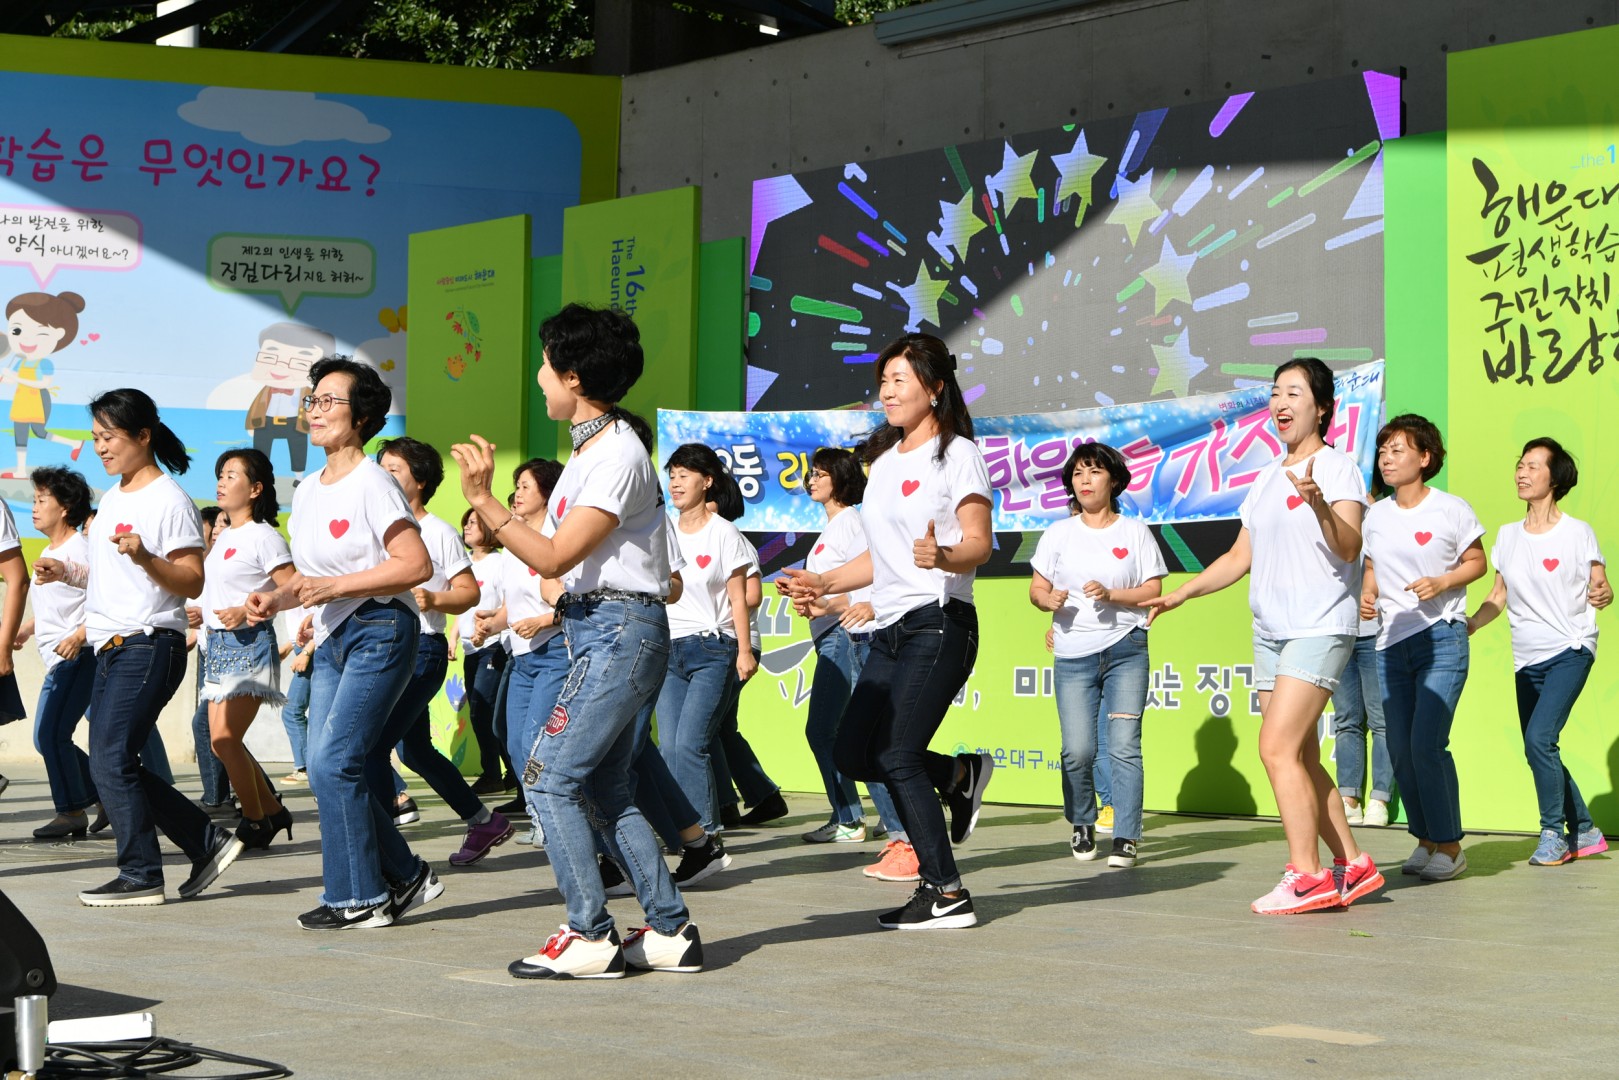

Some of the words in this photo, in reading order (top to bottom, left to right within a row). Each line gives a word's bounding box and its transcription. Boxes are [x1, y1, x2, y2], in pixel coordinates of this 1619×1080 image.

[138, 138, 382, 197] 무엇인가요?
[29, 215, 71, 232] 발전을
[77, 217, 104, 233] 위한
[7, 233, 46, 257] 양식
[50, 245, 129, 260] 아니겠어요~?
[241, 245, 274, 257] 제2의
[278, 246, 316, 262] 인생을
[319, 248, 346, 262] 위한
[626, 236, 636, 261] The
[220, 261, 302, 283] 징검다리
[303, 270, 327, 284] 지요
[329, 270, 365, 284] 허허~
[1479, 272, 1611, 345] 주민자치
